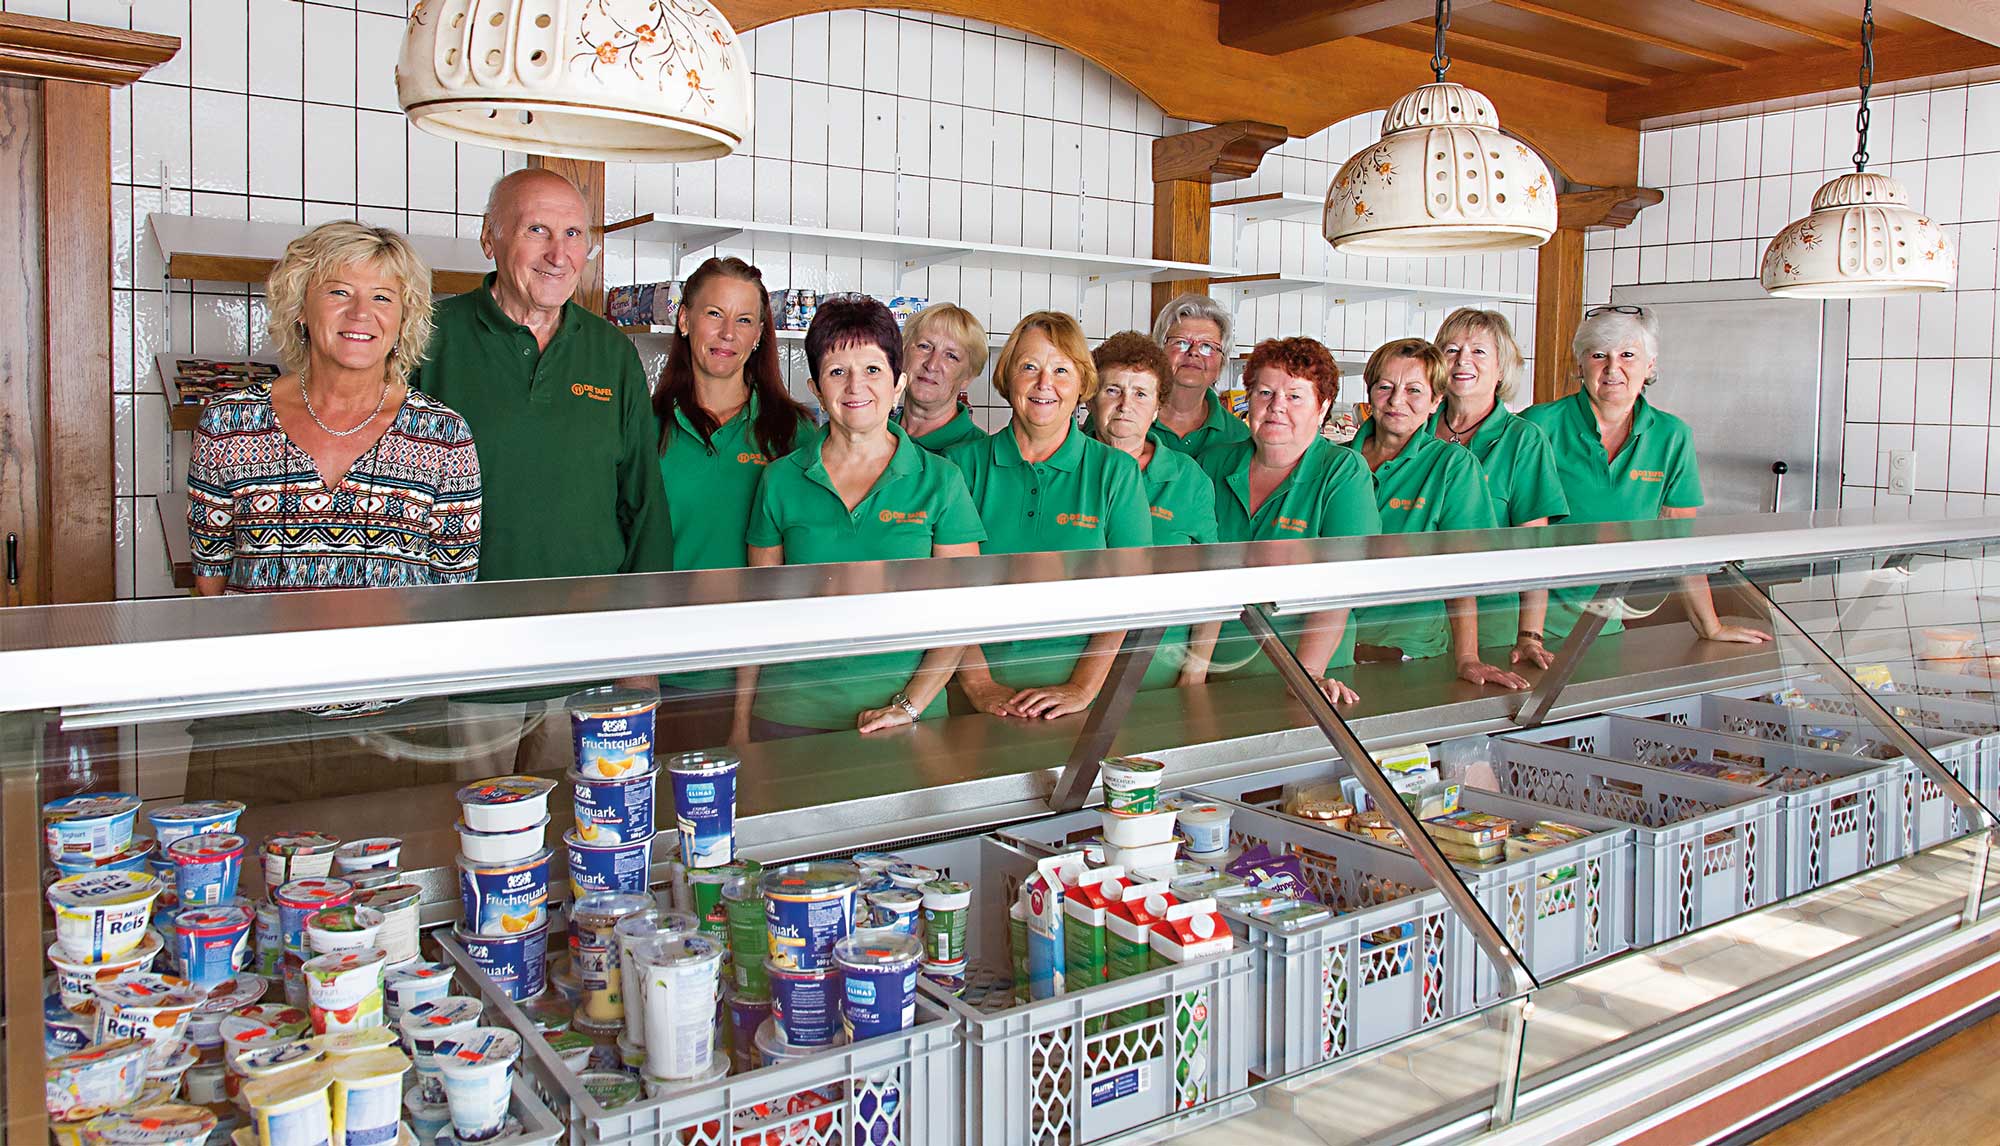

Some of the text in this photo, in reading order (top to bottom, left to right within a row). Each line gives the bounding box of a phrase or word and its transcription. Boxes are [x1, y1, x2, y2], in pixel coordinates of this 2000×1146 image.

[594, 387, 612, 396] TAFEL
[581, 732, 648, 751] Fruchtquark
[70, 880, 132, 898] Reis
[80, 874, 120, 886] Milch
[486, 882, 548, 906] Fruchtquark
[110, 915, 144, 935] Reis
[60, 976, 92, 994] Reis
[120, 1012, 150, 1023] Milch
[107, 1018, 146, 1040] Reis
